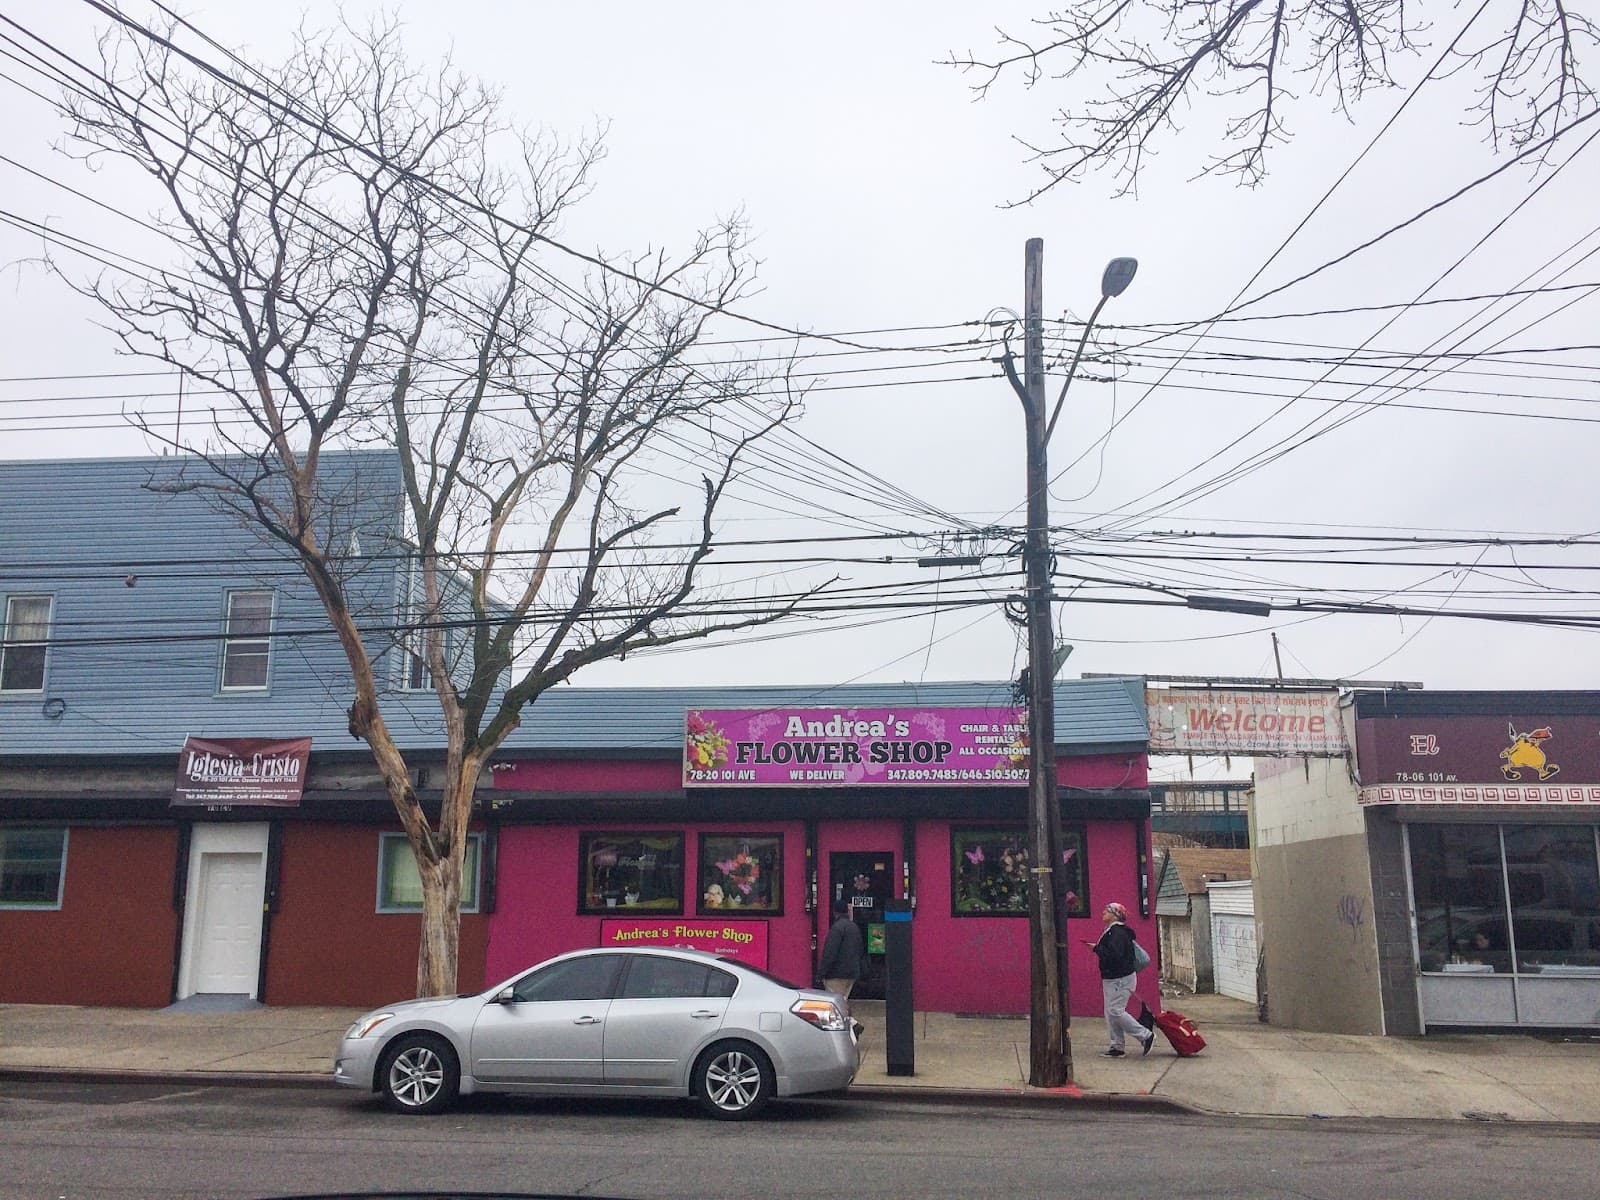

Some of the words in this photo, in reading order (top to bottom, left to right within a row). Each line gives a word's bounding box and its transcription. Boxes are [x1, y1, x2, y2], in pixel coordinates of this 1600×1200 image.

[784, 714, 910, 738] Andrea's
[1189, 708, 1325, 733] Welcome
[960, 724, 988, 733] CHAIR
[991, 724, 1000, 733] &
[974, 735, 1016, 744] RENTALS
[1409, 734, 1441, 756] El
[735, 740, 863, 765] FLOWER
[869, 740, 953, 765] SHOP
[959, 747, 975, 756] ALL
[186, 751, 244, 782] Iglesia
[253, 752, 300, 777] Cristo
[690, 769, 719, 780] 78-20
[721, 769, 736, 780] 101
[738, 769, 756, 780] AVE
[790, 769, 804, 780] WE
[806, 769, 845, 780] DELIVER
[1396, 772, 1425, 782] 78-06
[1428, 772, 1444, 782] 101
[1446, 774, 1459, 782] AV.
[853, 897, 871, 907] OPEN
[612, 927, 669, 941] Andrea's
[672, 926, 719, 939] Flower
[722, 928, 753, 943] Shop
